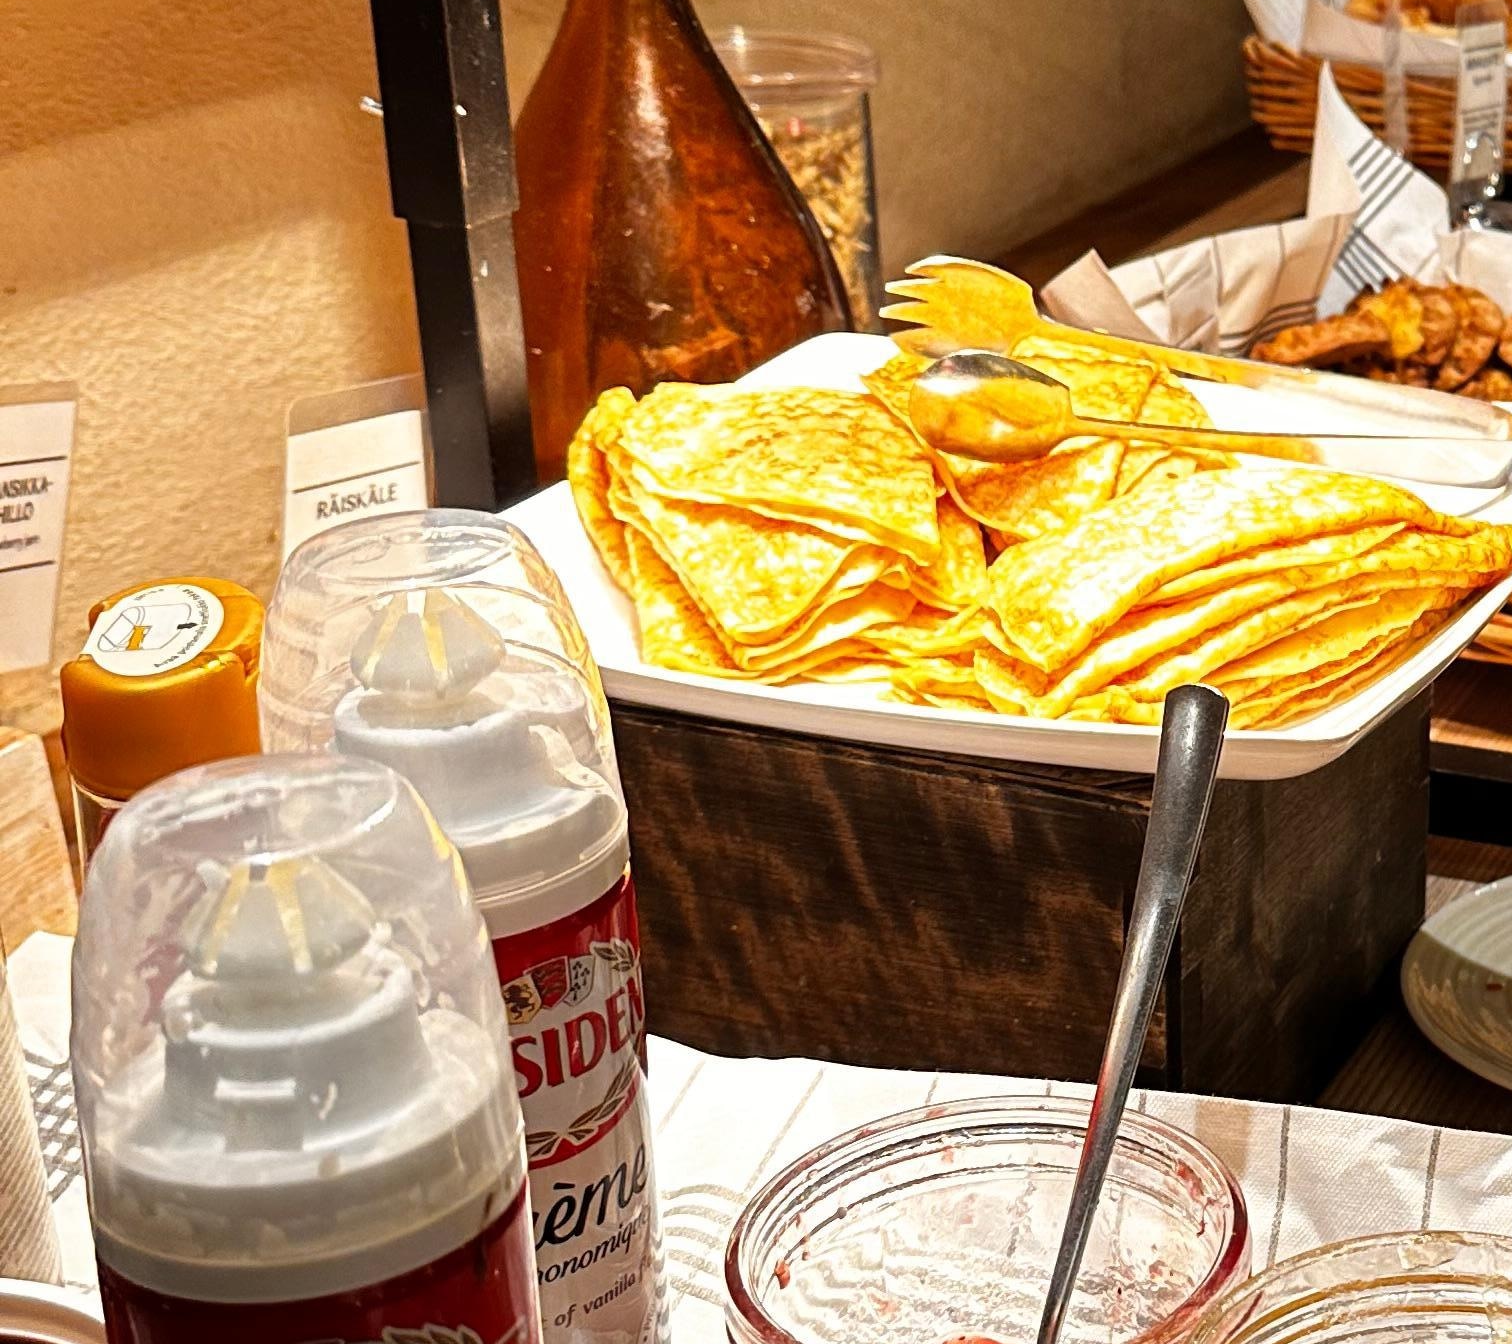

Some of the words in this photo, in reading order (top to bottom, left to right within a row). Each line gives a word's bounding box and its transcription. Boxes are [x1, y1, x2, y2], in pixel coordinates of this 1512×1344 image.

[316, 482, 398, 520] RÄISKÄLE
[554, 1304, 577, 1328] of
[583, 1272, 636, 1314] vanilla
